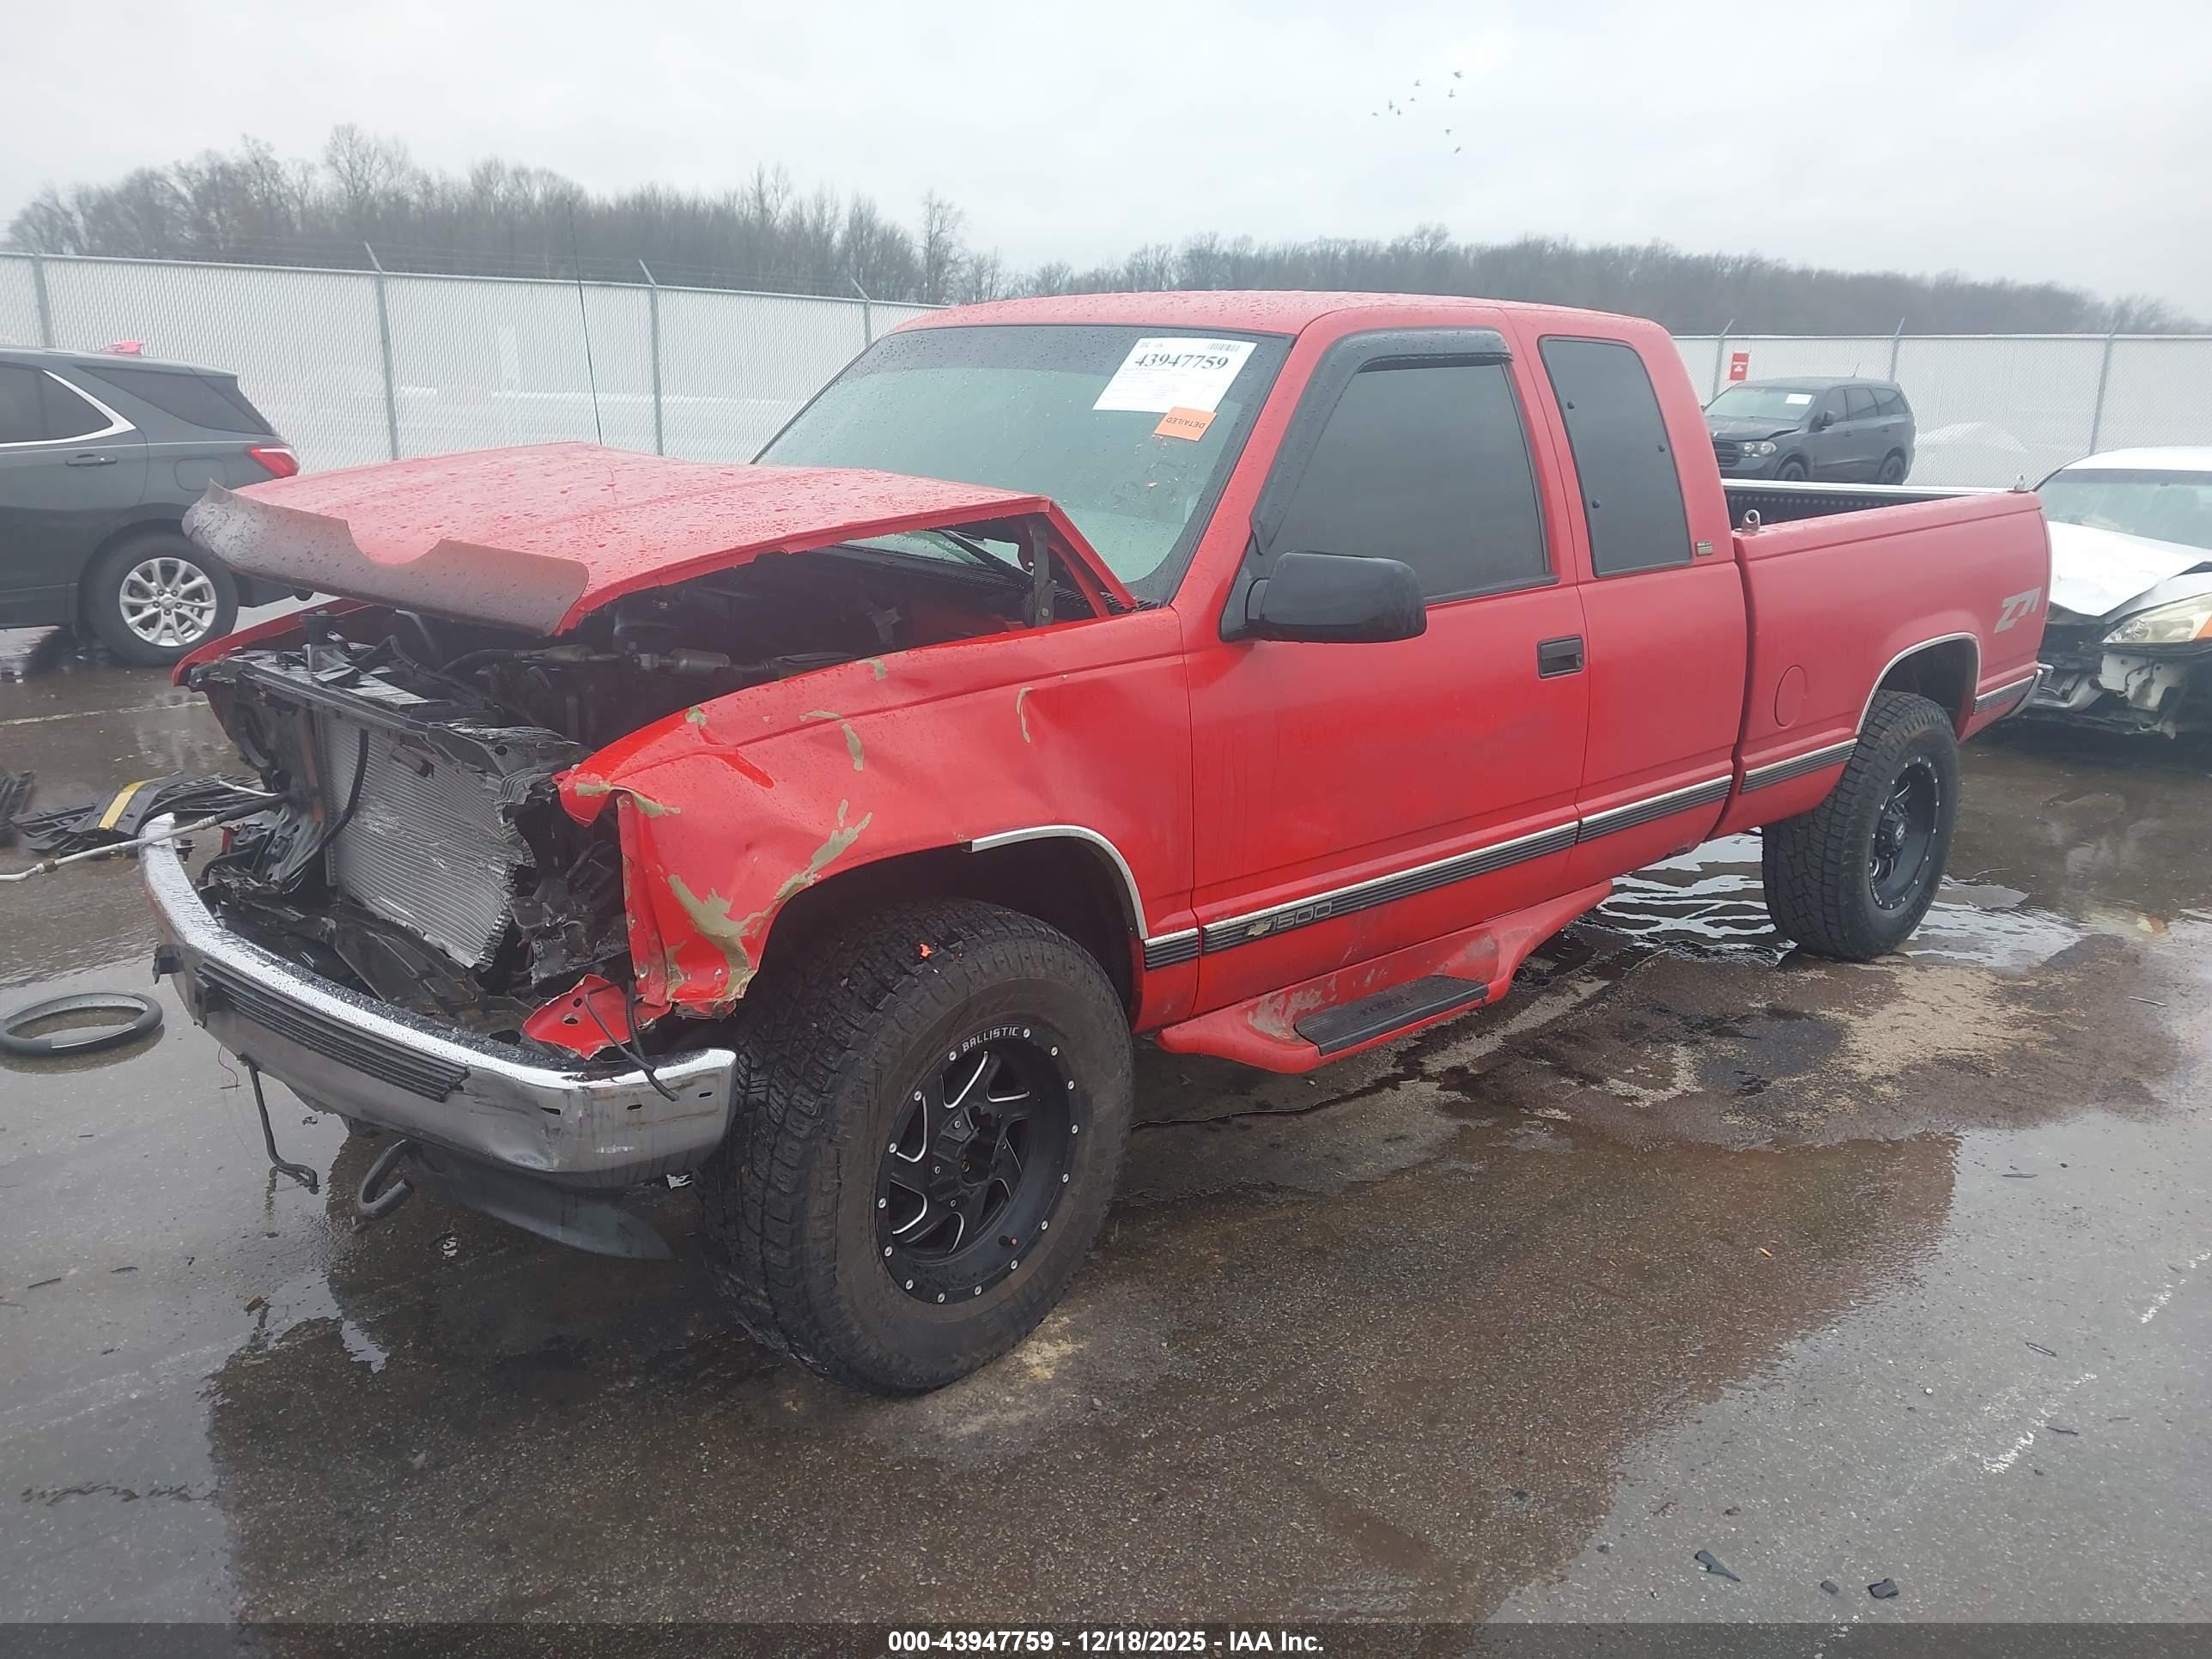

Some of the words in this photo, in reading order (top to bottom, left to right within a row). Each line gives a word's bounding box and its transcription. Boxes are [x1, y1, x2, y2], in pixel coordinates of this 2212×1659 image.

[1134, 353, 1229, 370] 43947759
[1165, 416, 1206, 429] DETAILED
[1992, 586, 2042, 634] Z71
[1267, 902, 1332, 931] 1500
[962, 1027, 1020, 1053] BALLISTIC
